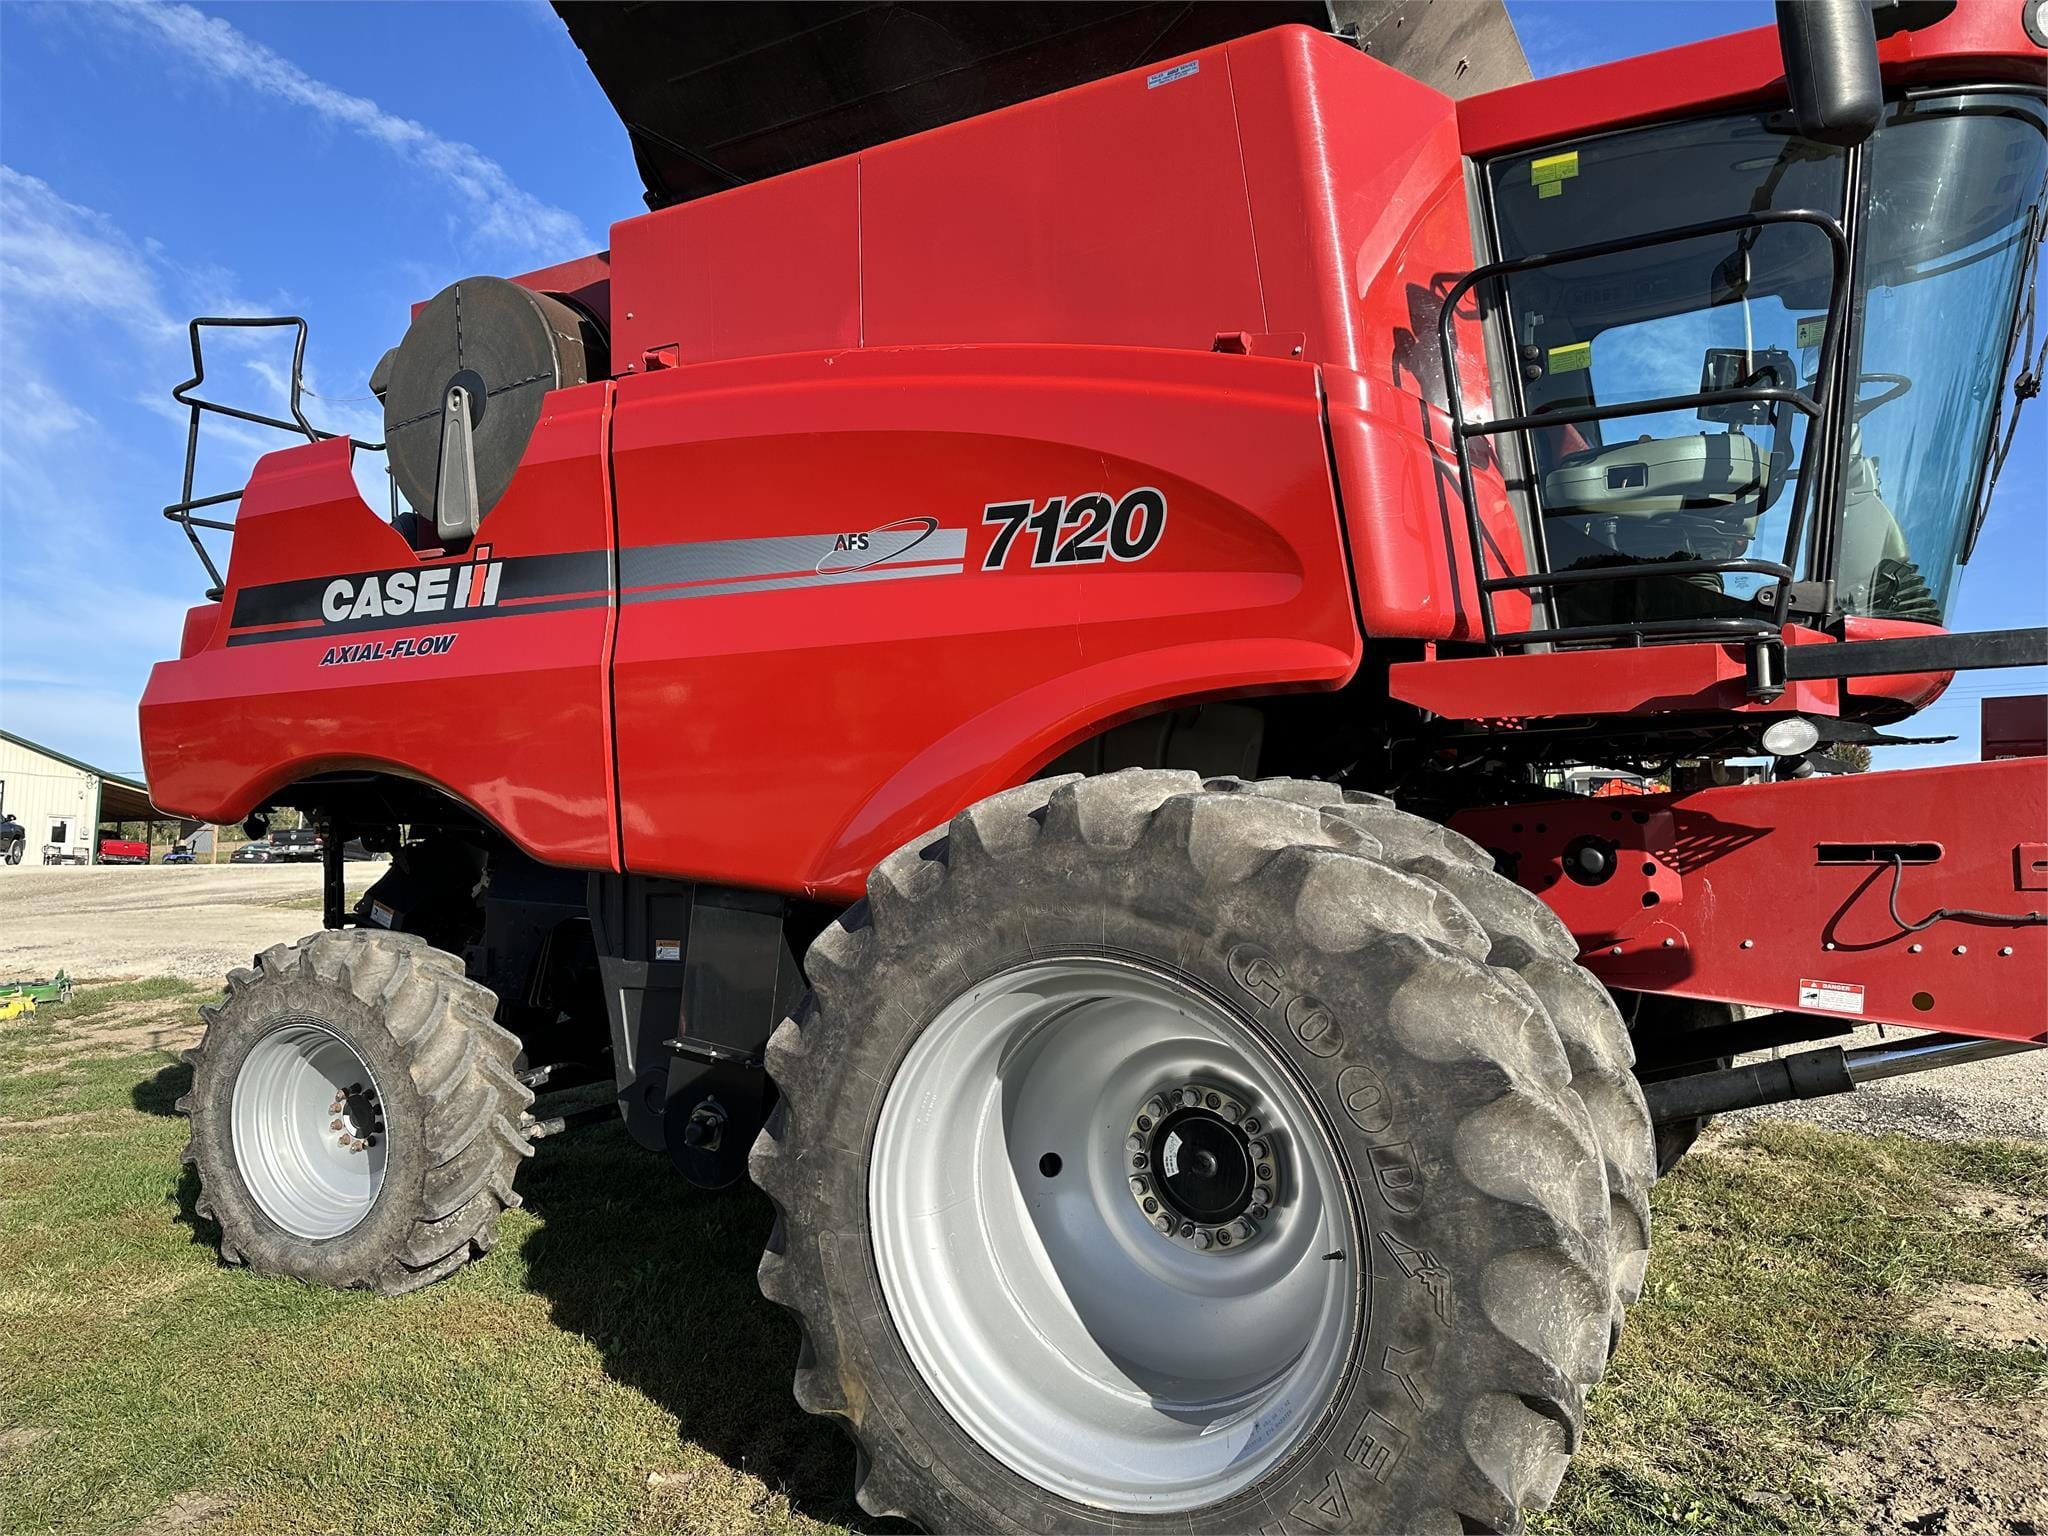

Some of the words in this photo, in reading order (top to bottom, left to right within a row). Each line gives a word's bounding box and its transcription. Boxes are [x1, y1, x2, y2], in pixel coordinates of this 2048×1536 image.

[833, 532, 870, 551] AFS
[981, 486, 1168, 571] 7120
[322, 568, 450, 622] CASE
[319, 633, 458, 667] AXIAL-FLOW
[1822, 983, 1851, 992] DANGER
